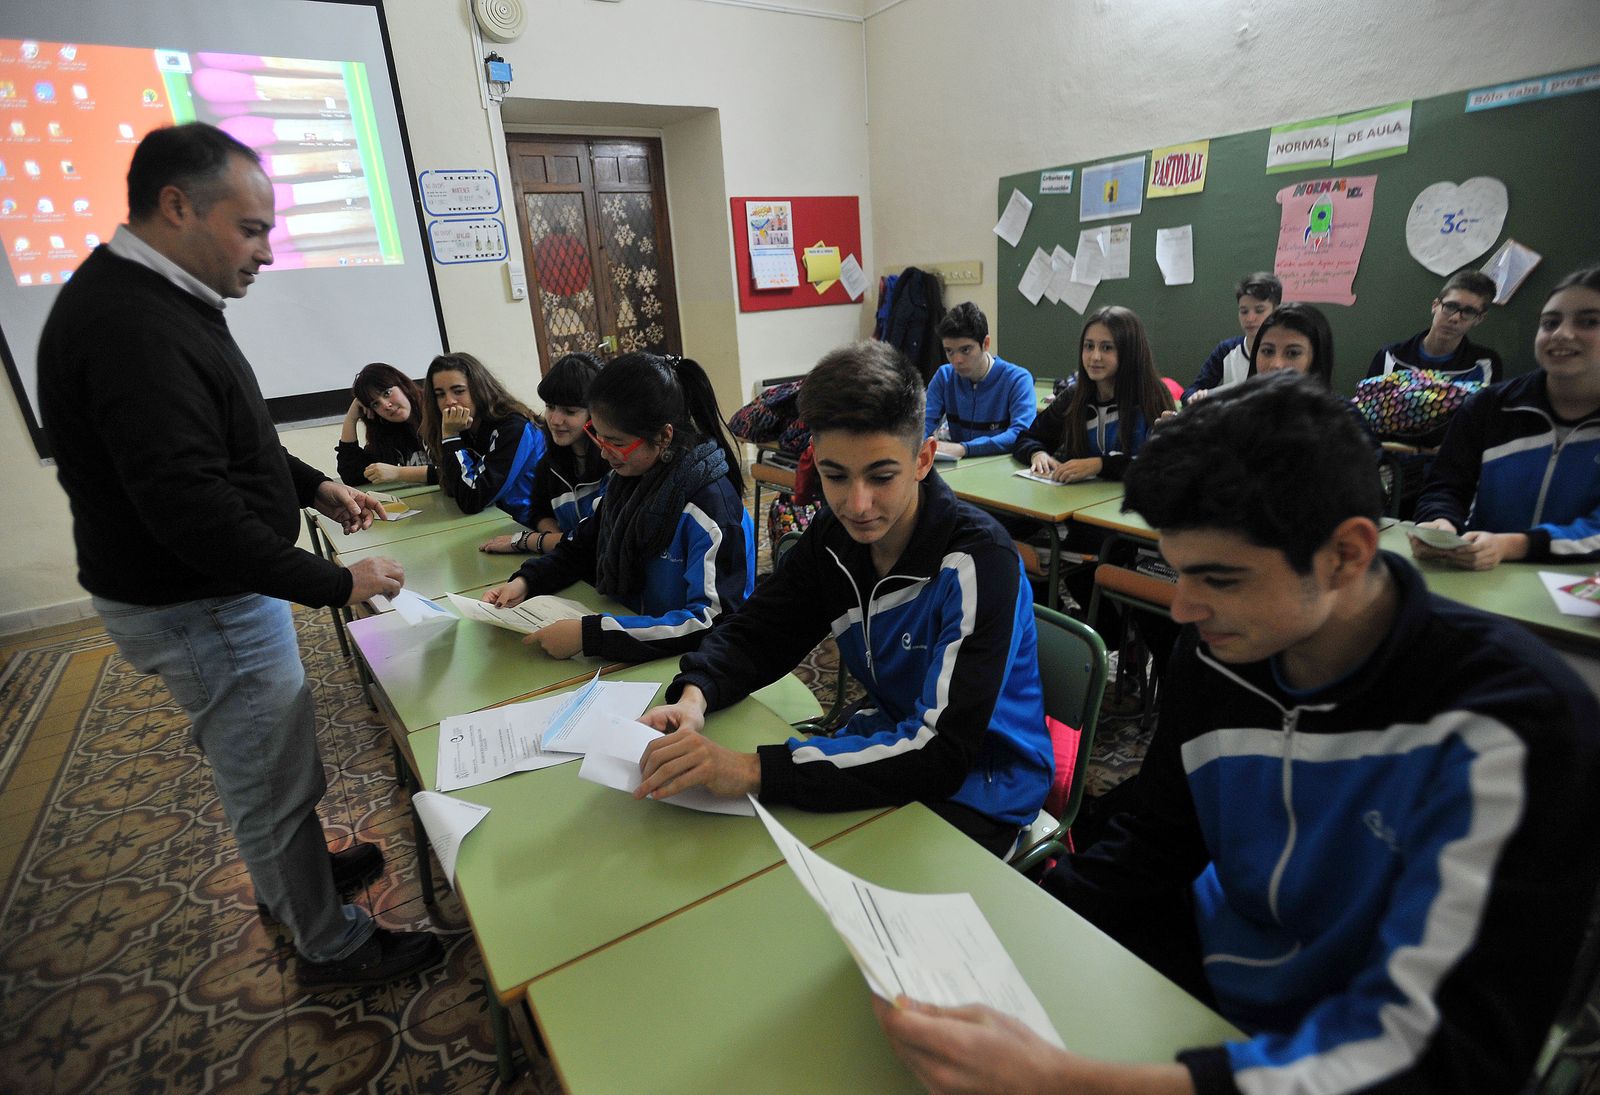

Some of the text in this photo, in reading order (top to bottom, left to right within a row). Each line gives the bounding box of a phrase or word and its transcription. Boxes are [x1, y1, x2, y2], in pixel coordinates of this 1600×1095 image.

[1275, 121, 1402, 155] NORMAS DE AULA
[1152, 152, 1204, 187] PASTORAL
[1293, 178, 1347, 198] NORMAS
